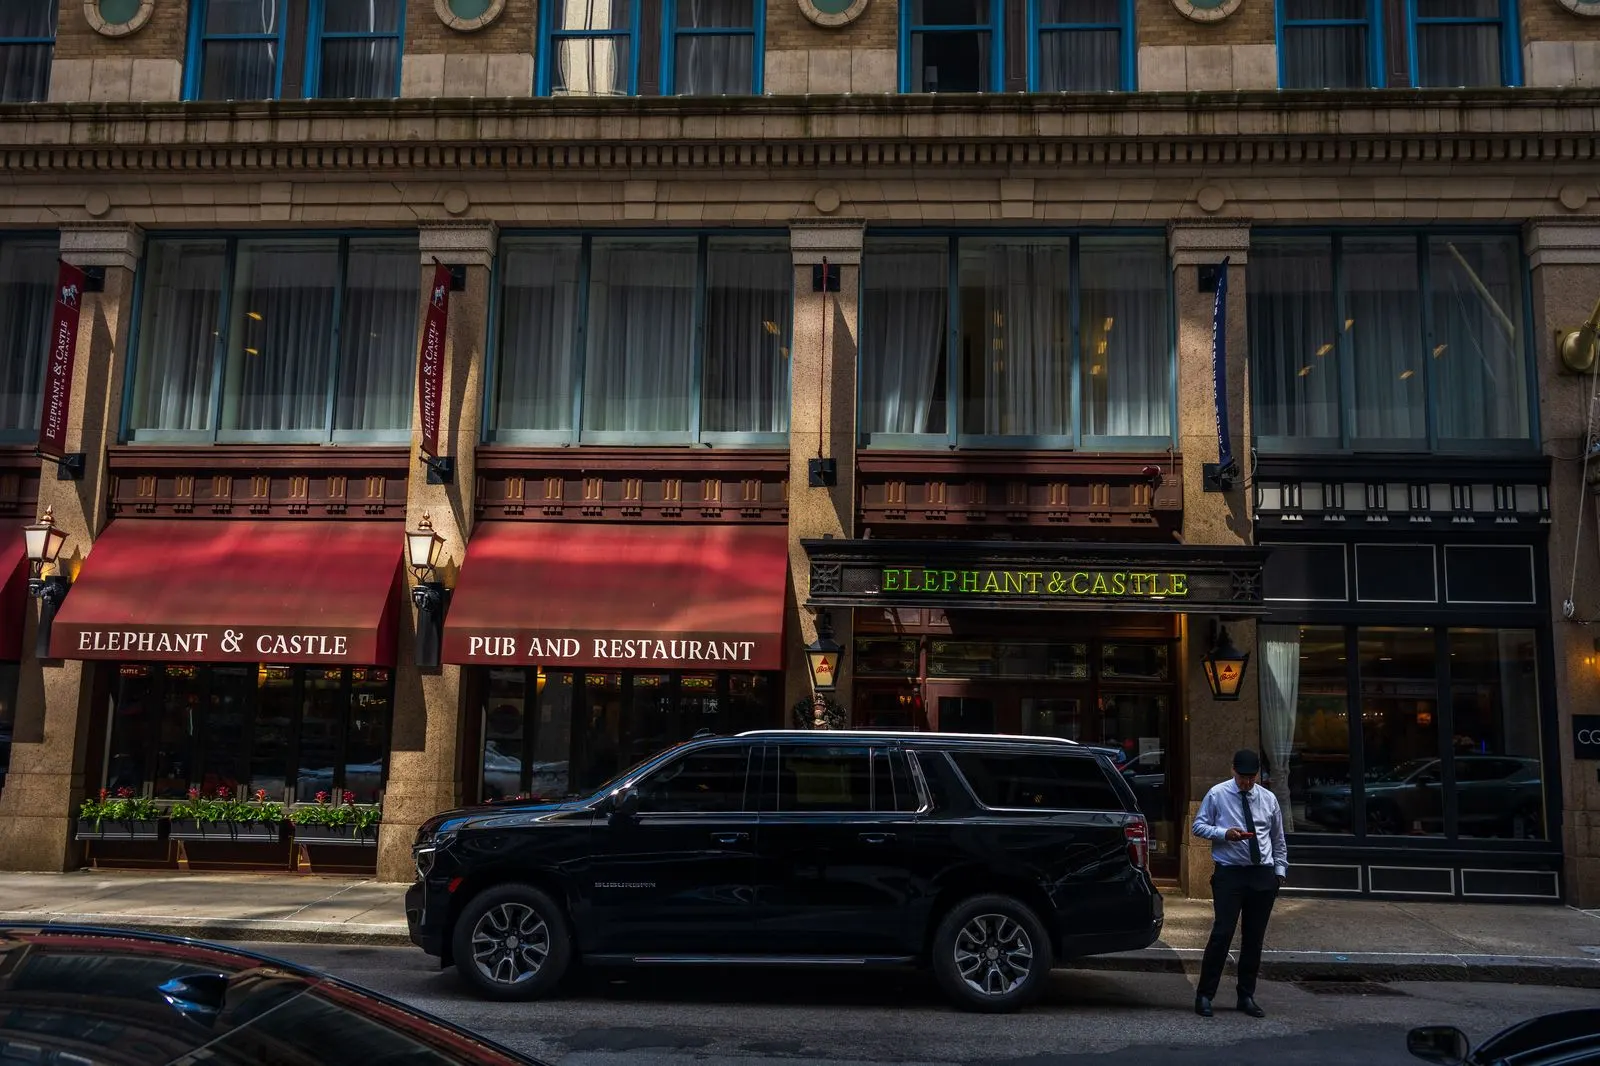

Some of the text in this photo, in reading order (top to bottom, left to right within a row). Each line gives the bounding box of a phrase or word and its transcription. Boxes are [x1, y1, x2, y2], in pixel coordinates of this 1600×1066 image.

[46, 320, 68, 439] ELEPHANT & CASTLE
[423, 320, 436, 439] ELEPHANT & CASTLE
[78, 629, 348, 655] ELEPHANT & CASTLE
[468, 636, 755, 661] PUB AND RESTAURANT
